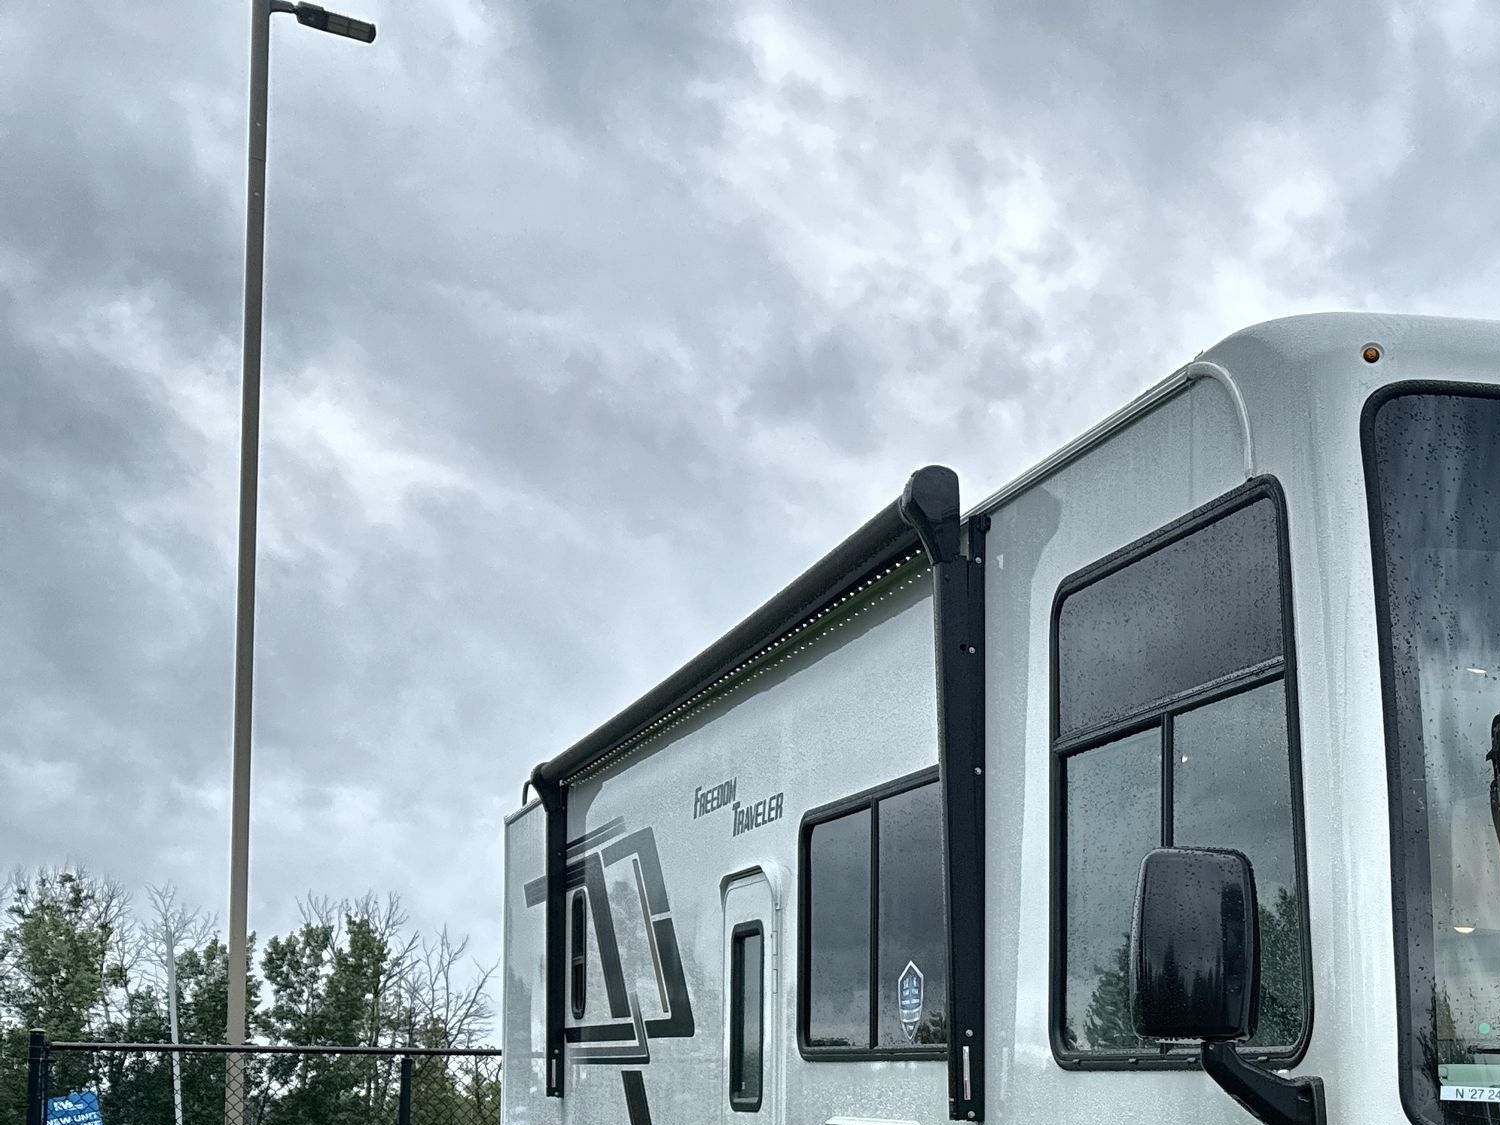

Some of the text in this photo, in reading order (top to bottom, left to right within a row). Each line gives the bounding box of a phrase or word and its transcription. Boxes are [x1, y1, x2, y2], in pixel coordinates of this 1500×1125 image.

[692, 776, 737, 820] FREEDOM
[732, 791, 784, 837] TRAVELER
[1455, 1088, 1464, 1099] N
